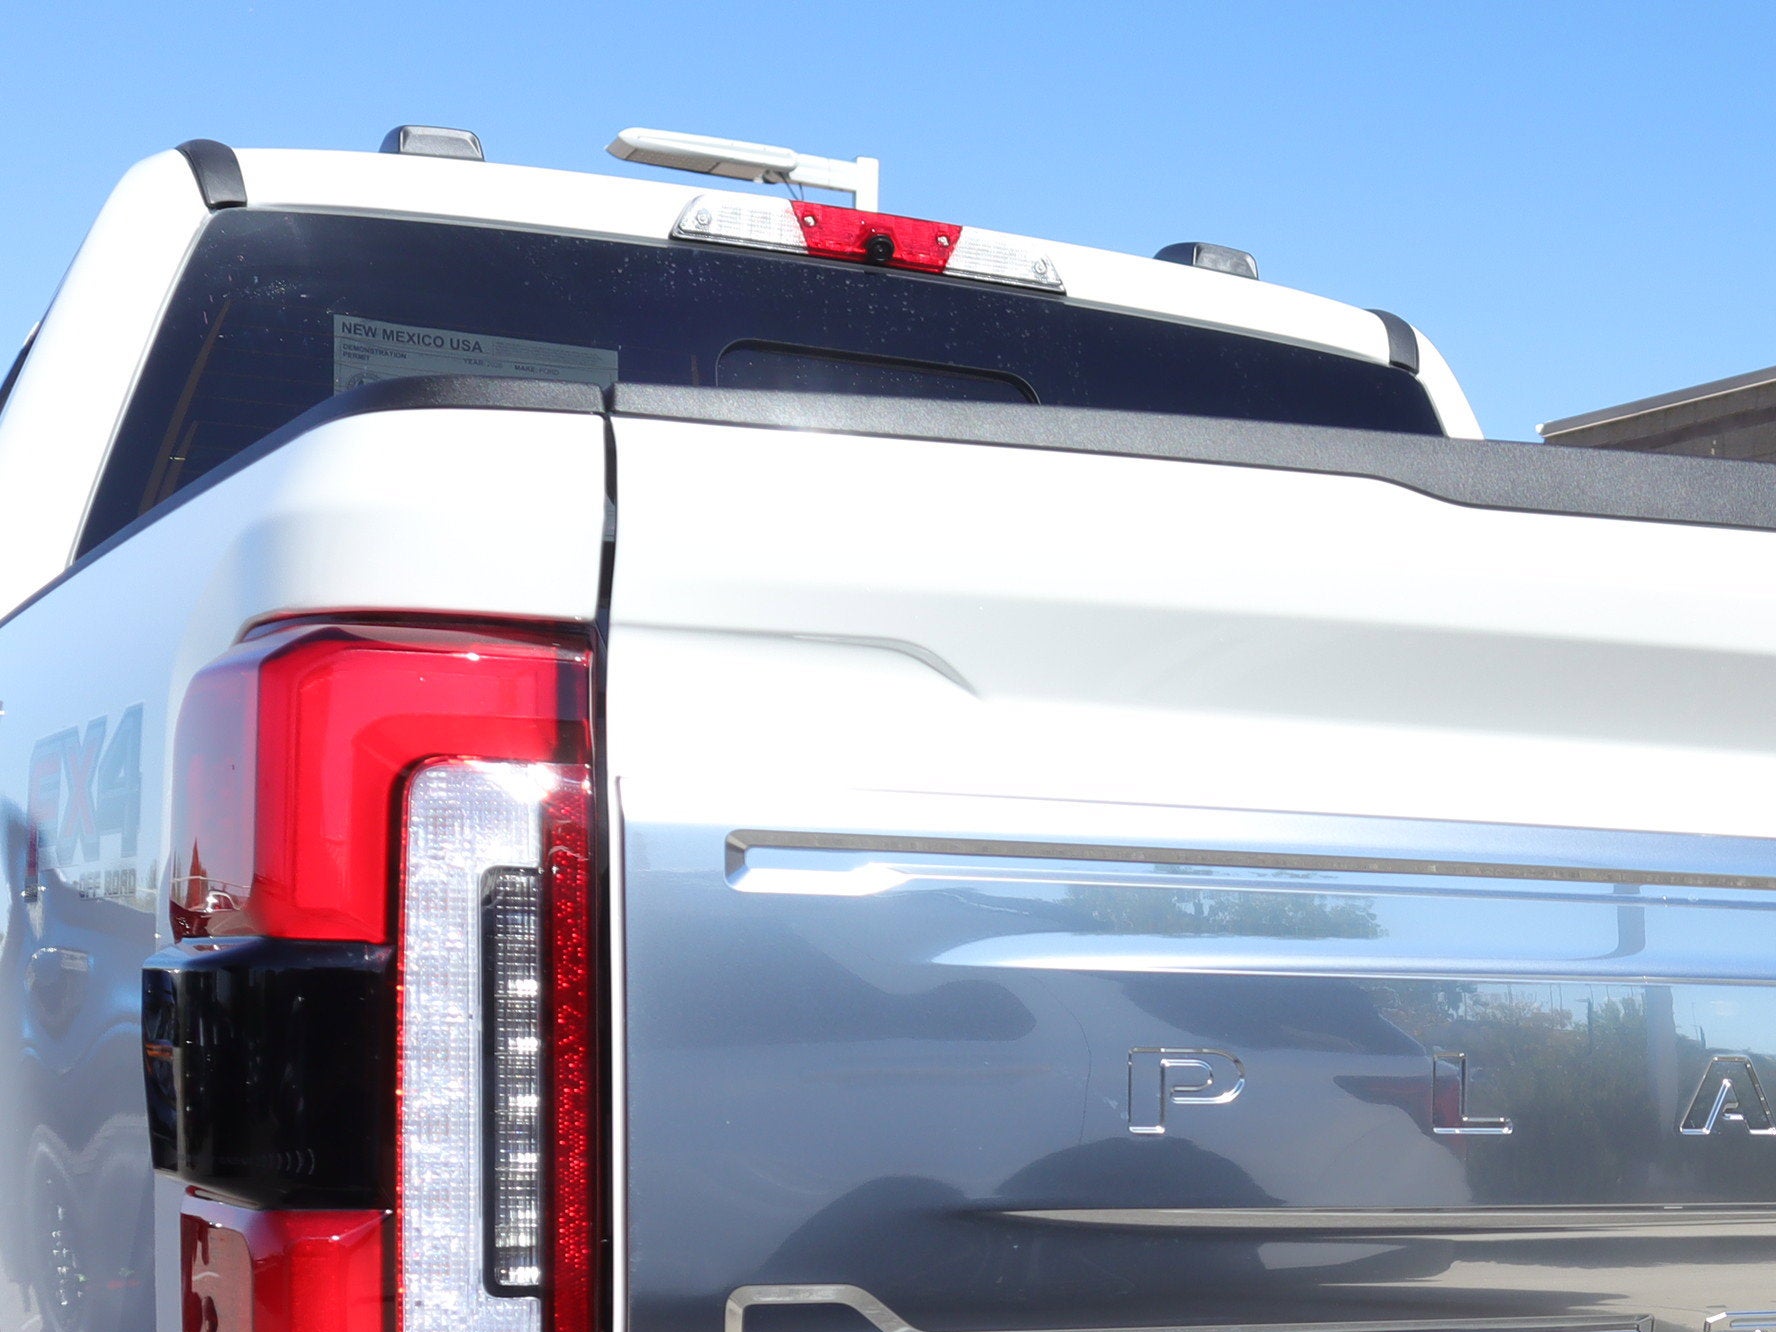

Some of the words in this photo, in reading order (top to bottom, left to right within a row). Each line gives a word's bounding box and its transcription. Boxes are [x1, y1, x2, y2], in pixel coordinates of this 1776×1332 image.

[341, 321, 377, 339] NEW
[382, 329, 445, 348] MEXICO
[450, 337, 483, 354] USA
[342, 343, 407, 359] DEMONSTRATION
[342, 351, 370, 361] PERMIT
[104, 867, 136, 897] ROAD
